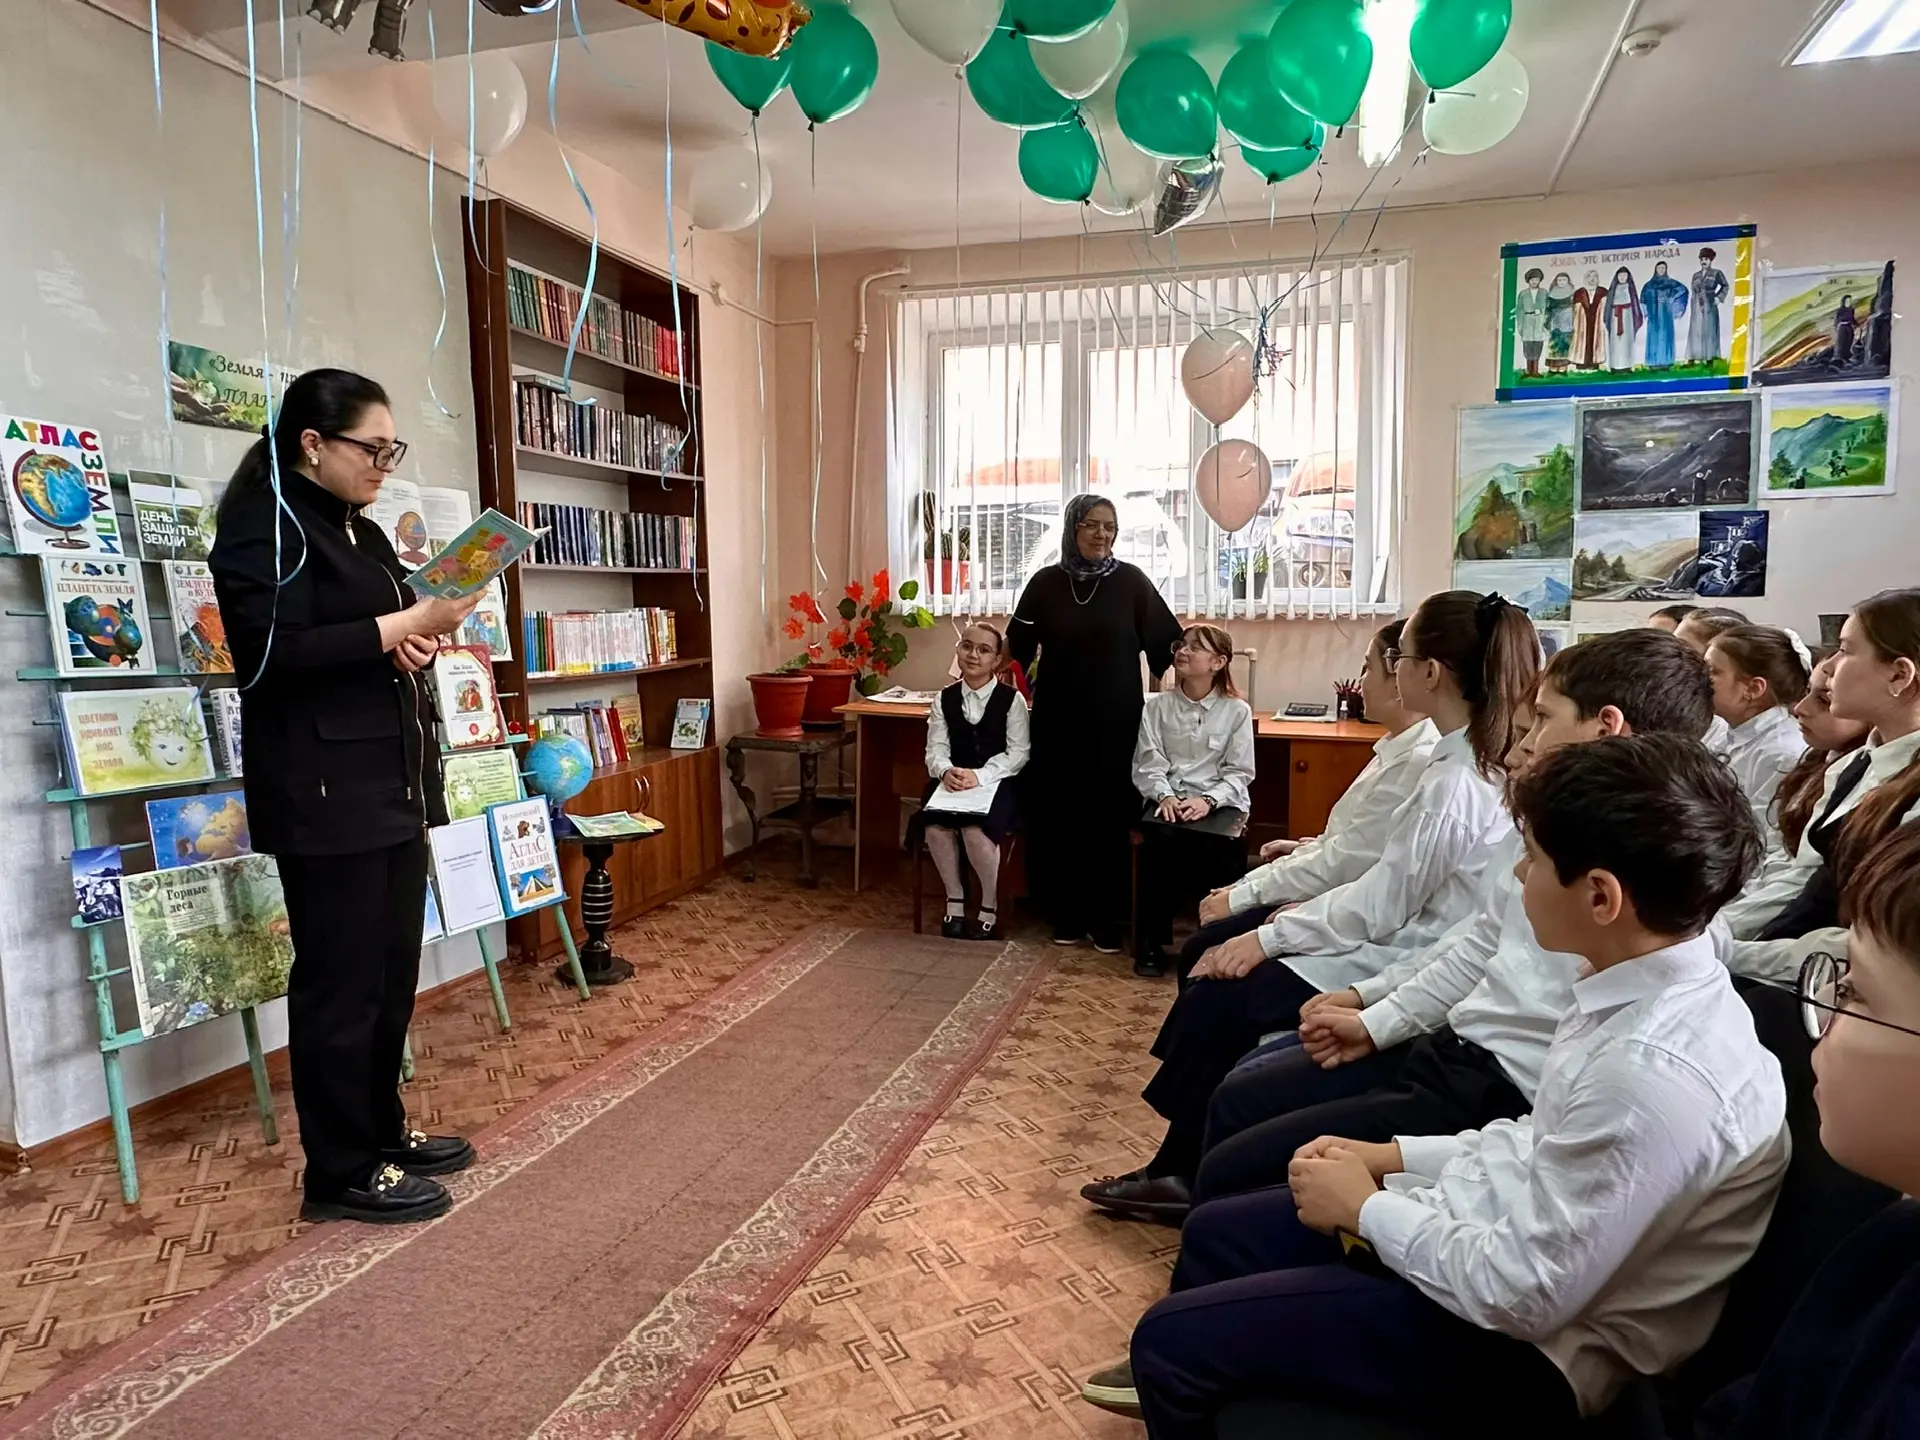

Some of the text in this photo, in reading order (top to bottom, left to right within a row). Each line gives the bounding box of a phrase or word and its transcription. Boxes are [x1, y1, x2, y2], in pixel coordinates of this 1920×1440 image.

[1583, 255, 1598, 265] ЭТО
[1601, 251, 1640, 263] ИСТОРИЯ
[1644, 247, 1681, 259] НАРОДА
[4, 418, 100, 452] АТЛАС
[81, 451, 121, 555] ЗЕМЛИ
[139, 510, 174, 523] ДЕНЬ
[141, 521, 199, 537] ЗАЩИТЫ
[143, 532, 187, 548] ЗЕМЛИ
[56, 582, 136, 595] ПЛАНЕТА ЗЕМЛЯ
[166, 885, 208, 901] Горные
[169, 900, 194, 914] леса
